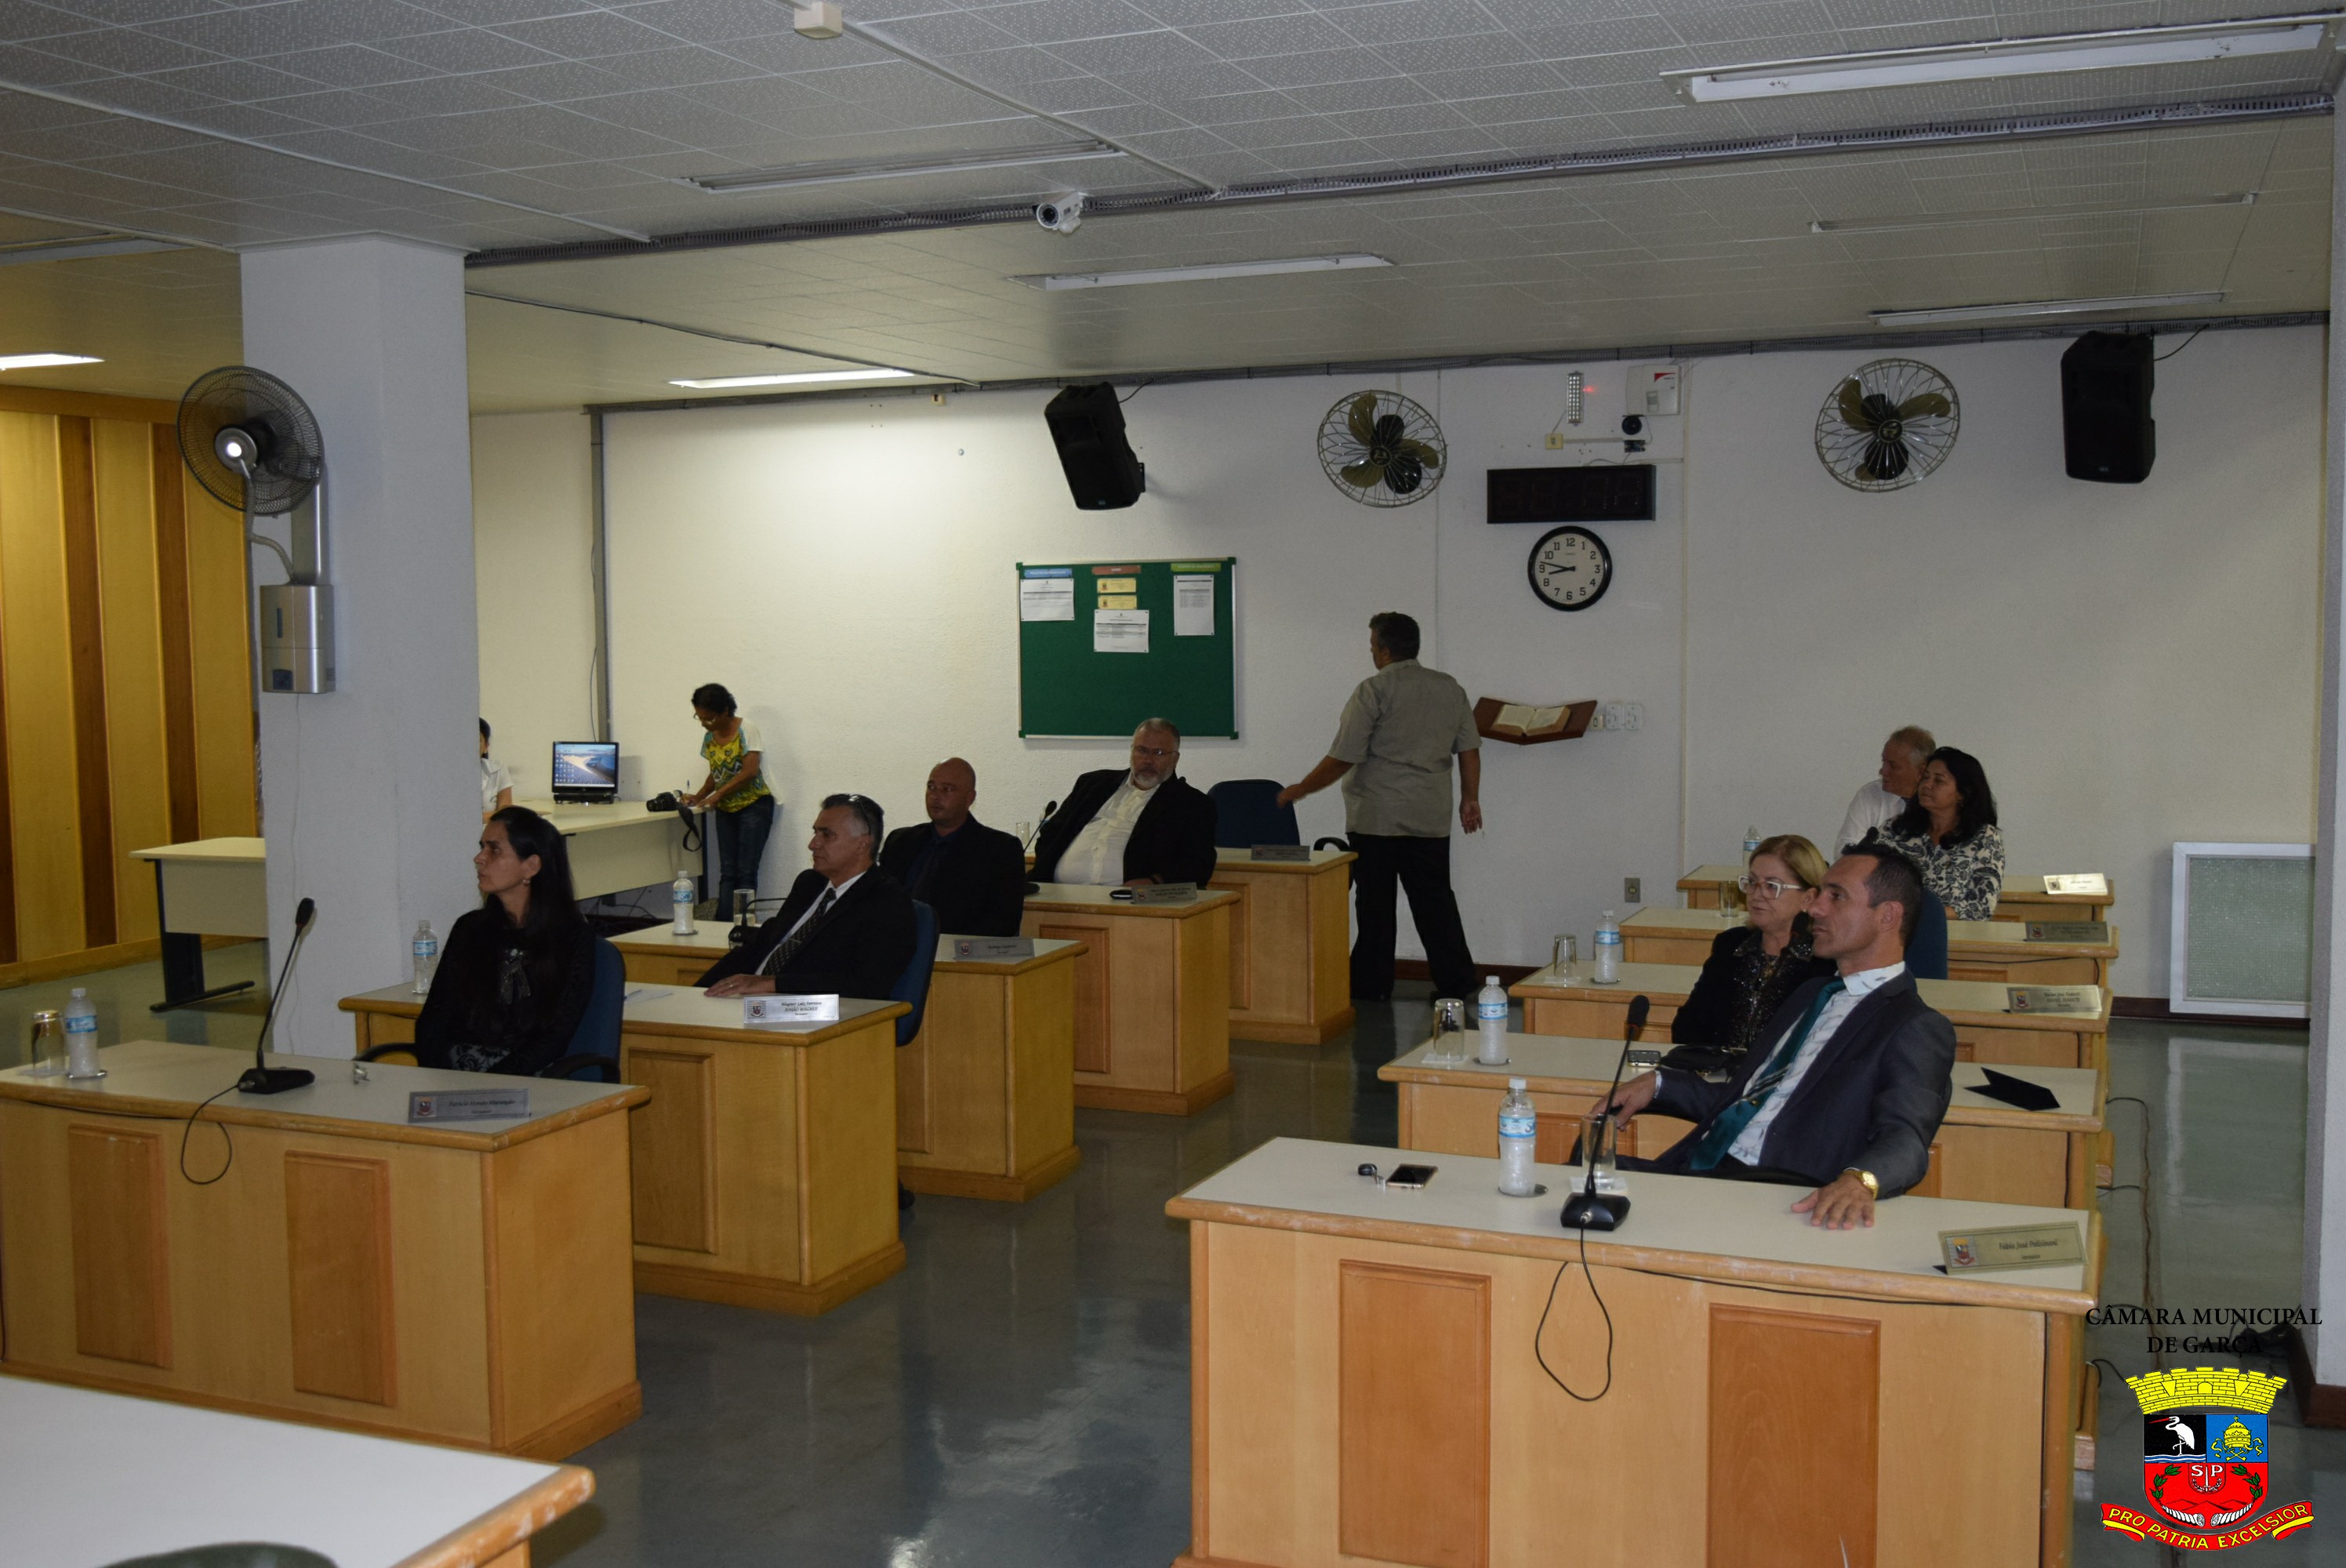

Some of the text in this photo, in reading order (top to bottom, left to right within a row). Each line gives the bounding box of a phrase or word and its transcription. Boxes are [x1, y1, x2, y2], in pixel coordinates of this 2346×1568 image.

[1553, 542, 1560, 550] 11
[1567, 538, 1575, 546] 12
[1567, 591, 1572, 600] 6
[1579, 587, 1586, 596] 5
